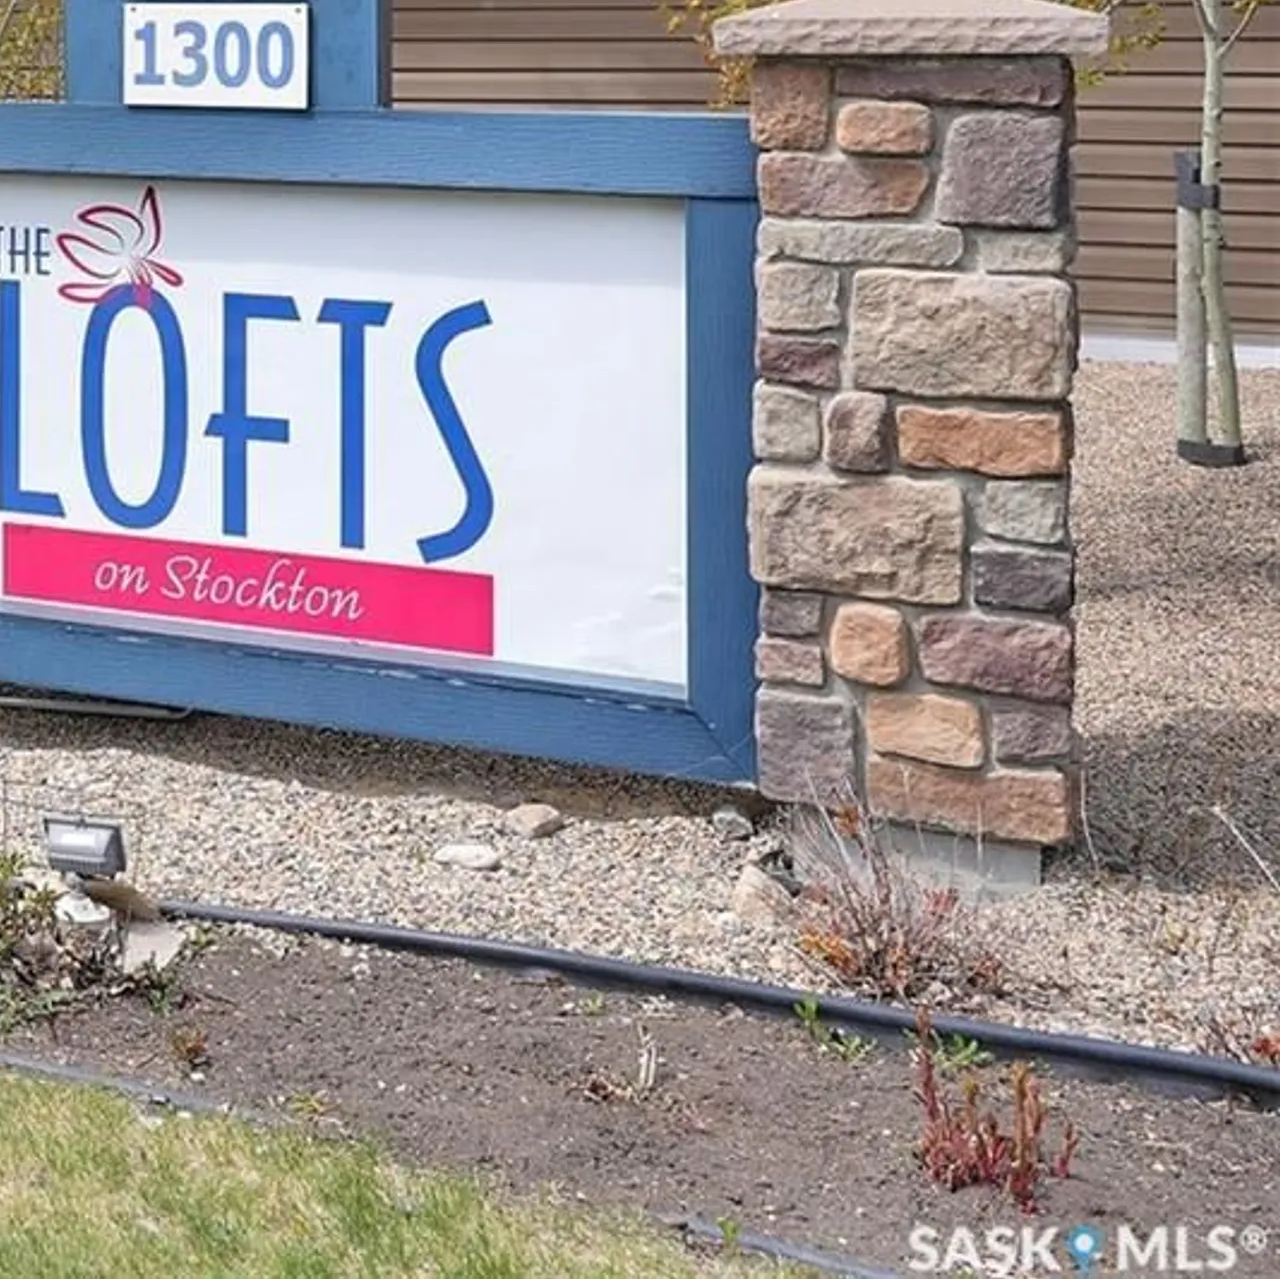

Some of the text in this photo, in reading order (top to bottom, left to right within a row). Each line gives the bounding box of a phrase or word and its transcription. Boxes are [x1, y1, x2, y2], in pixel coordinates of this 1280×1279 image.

[133, 20, 294, 88] 1300
[95, 554, 364, 621] on Stockton
